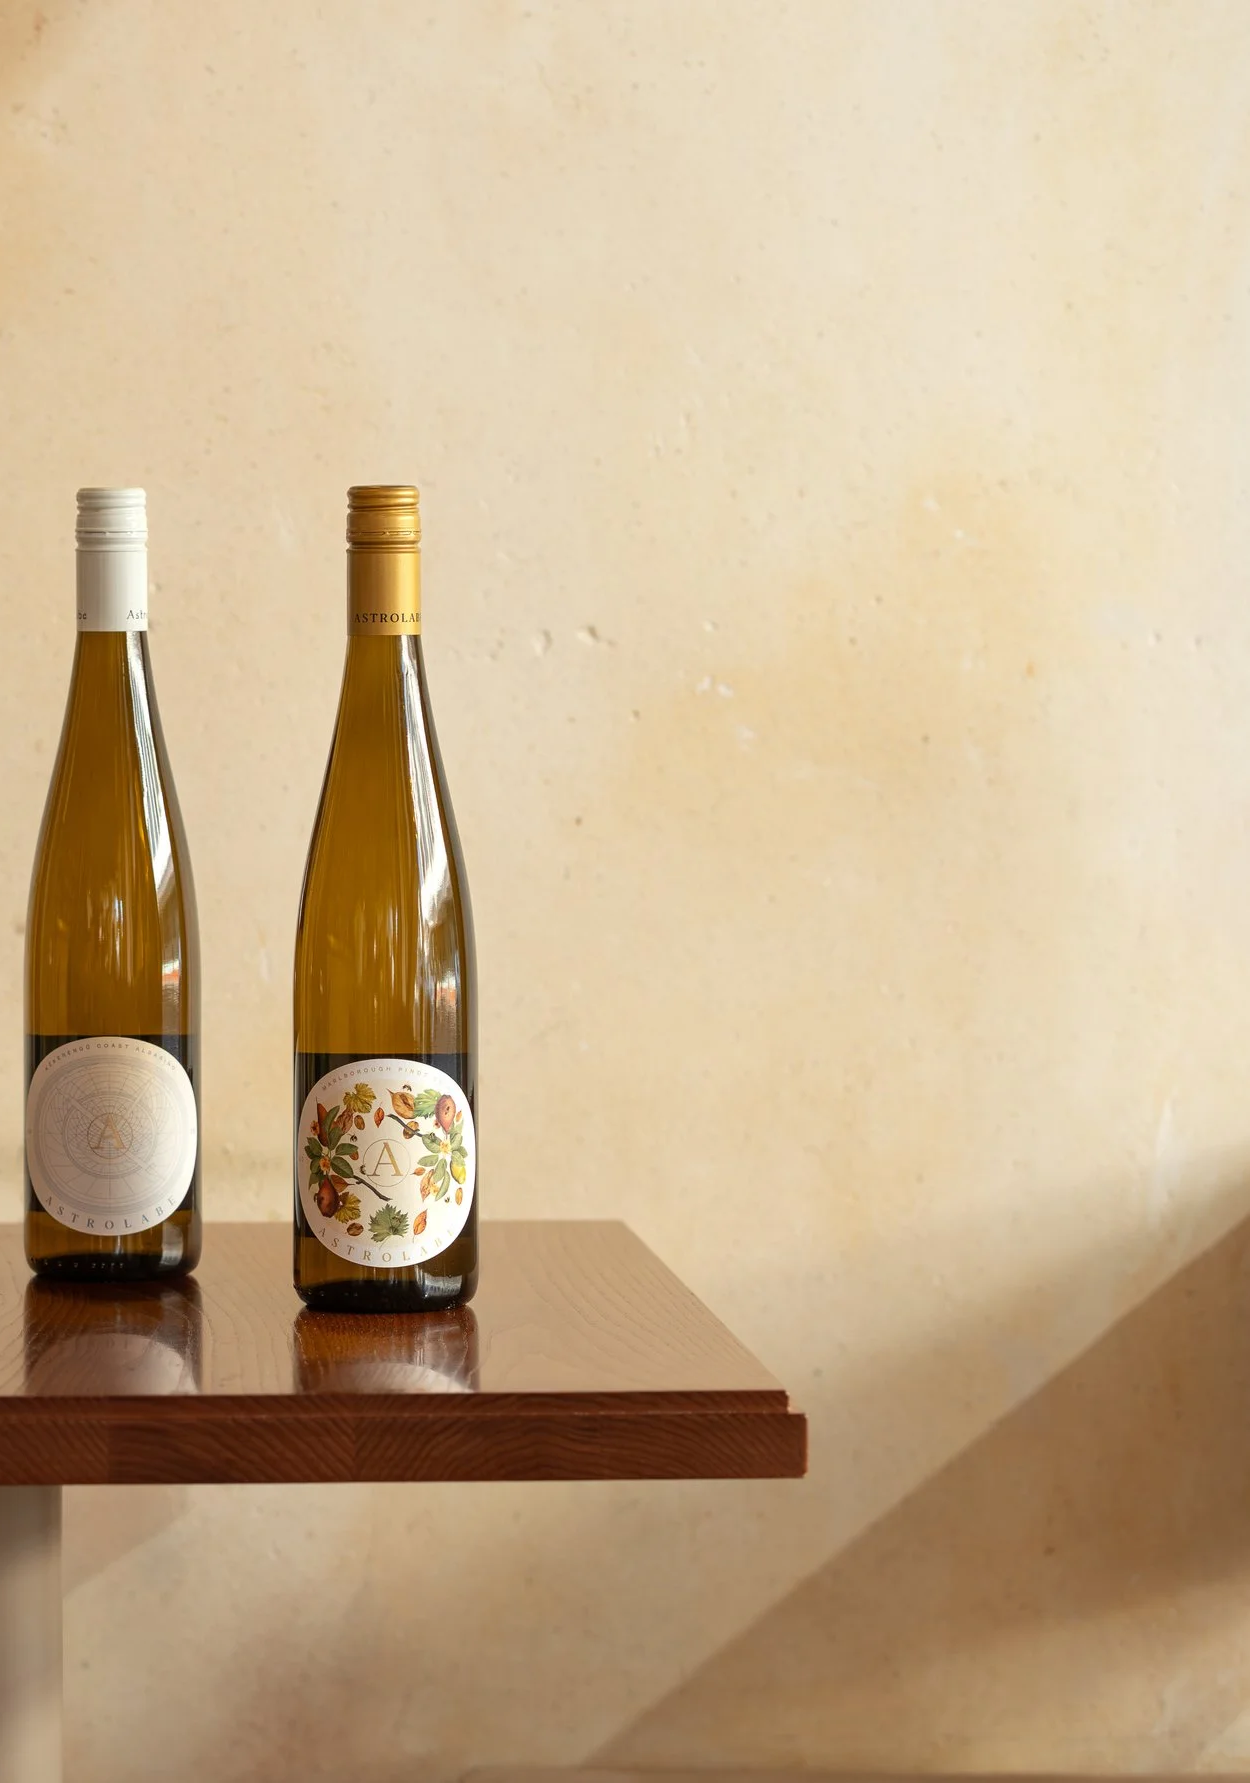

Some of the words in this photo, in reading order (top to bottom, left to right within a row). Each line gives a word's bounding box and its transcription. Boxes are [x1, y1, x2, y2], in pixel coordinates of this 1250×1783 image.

[322, 1066, 391, 1091] MARLBOROUGH
[92, 1114, 128, 1150] A
[366, 1142, 404, 1177] A
[44, 1196, 176, 1231] ASTROLABE
